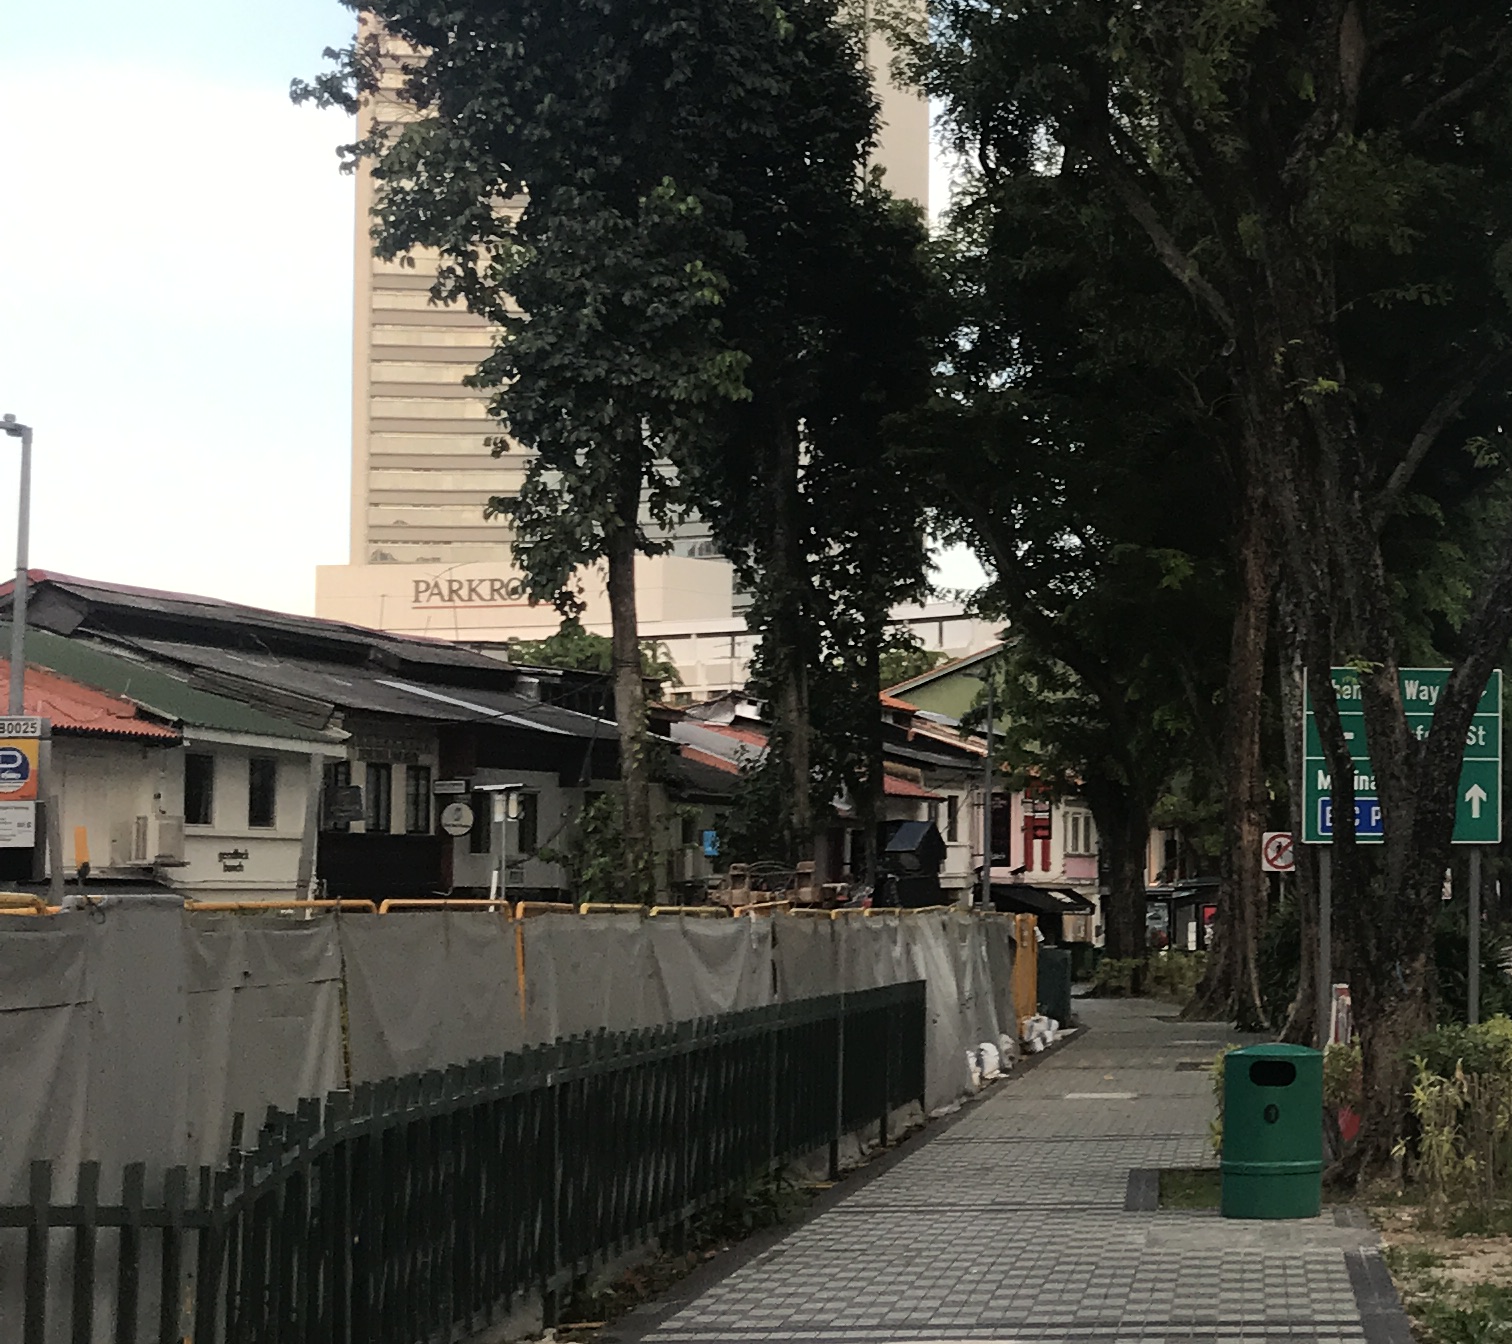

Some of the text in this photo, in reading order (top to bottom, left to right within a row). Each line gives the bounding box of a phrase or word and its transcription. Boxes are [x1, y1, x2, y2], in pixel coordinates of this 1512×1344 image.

[412, 577, 525, 603] PARKRO
[1404, 680, 1440, 705] Way
[1466, 725, 1487, 746] St
